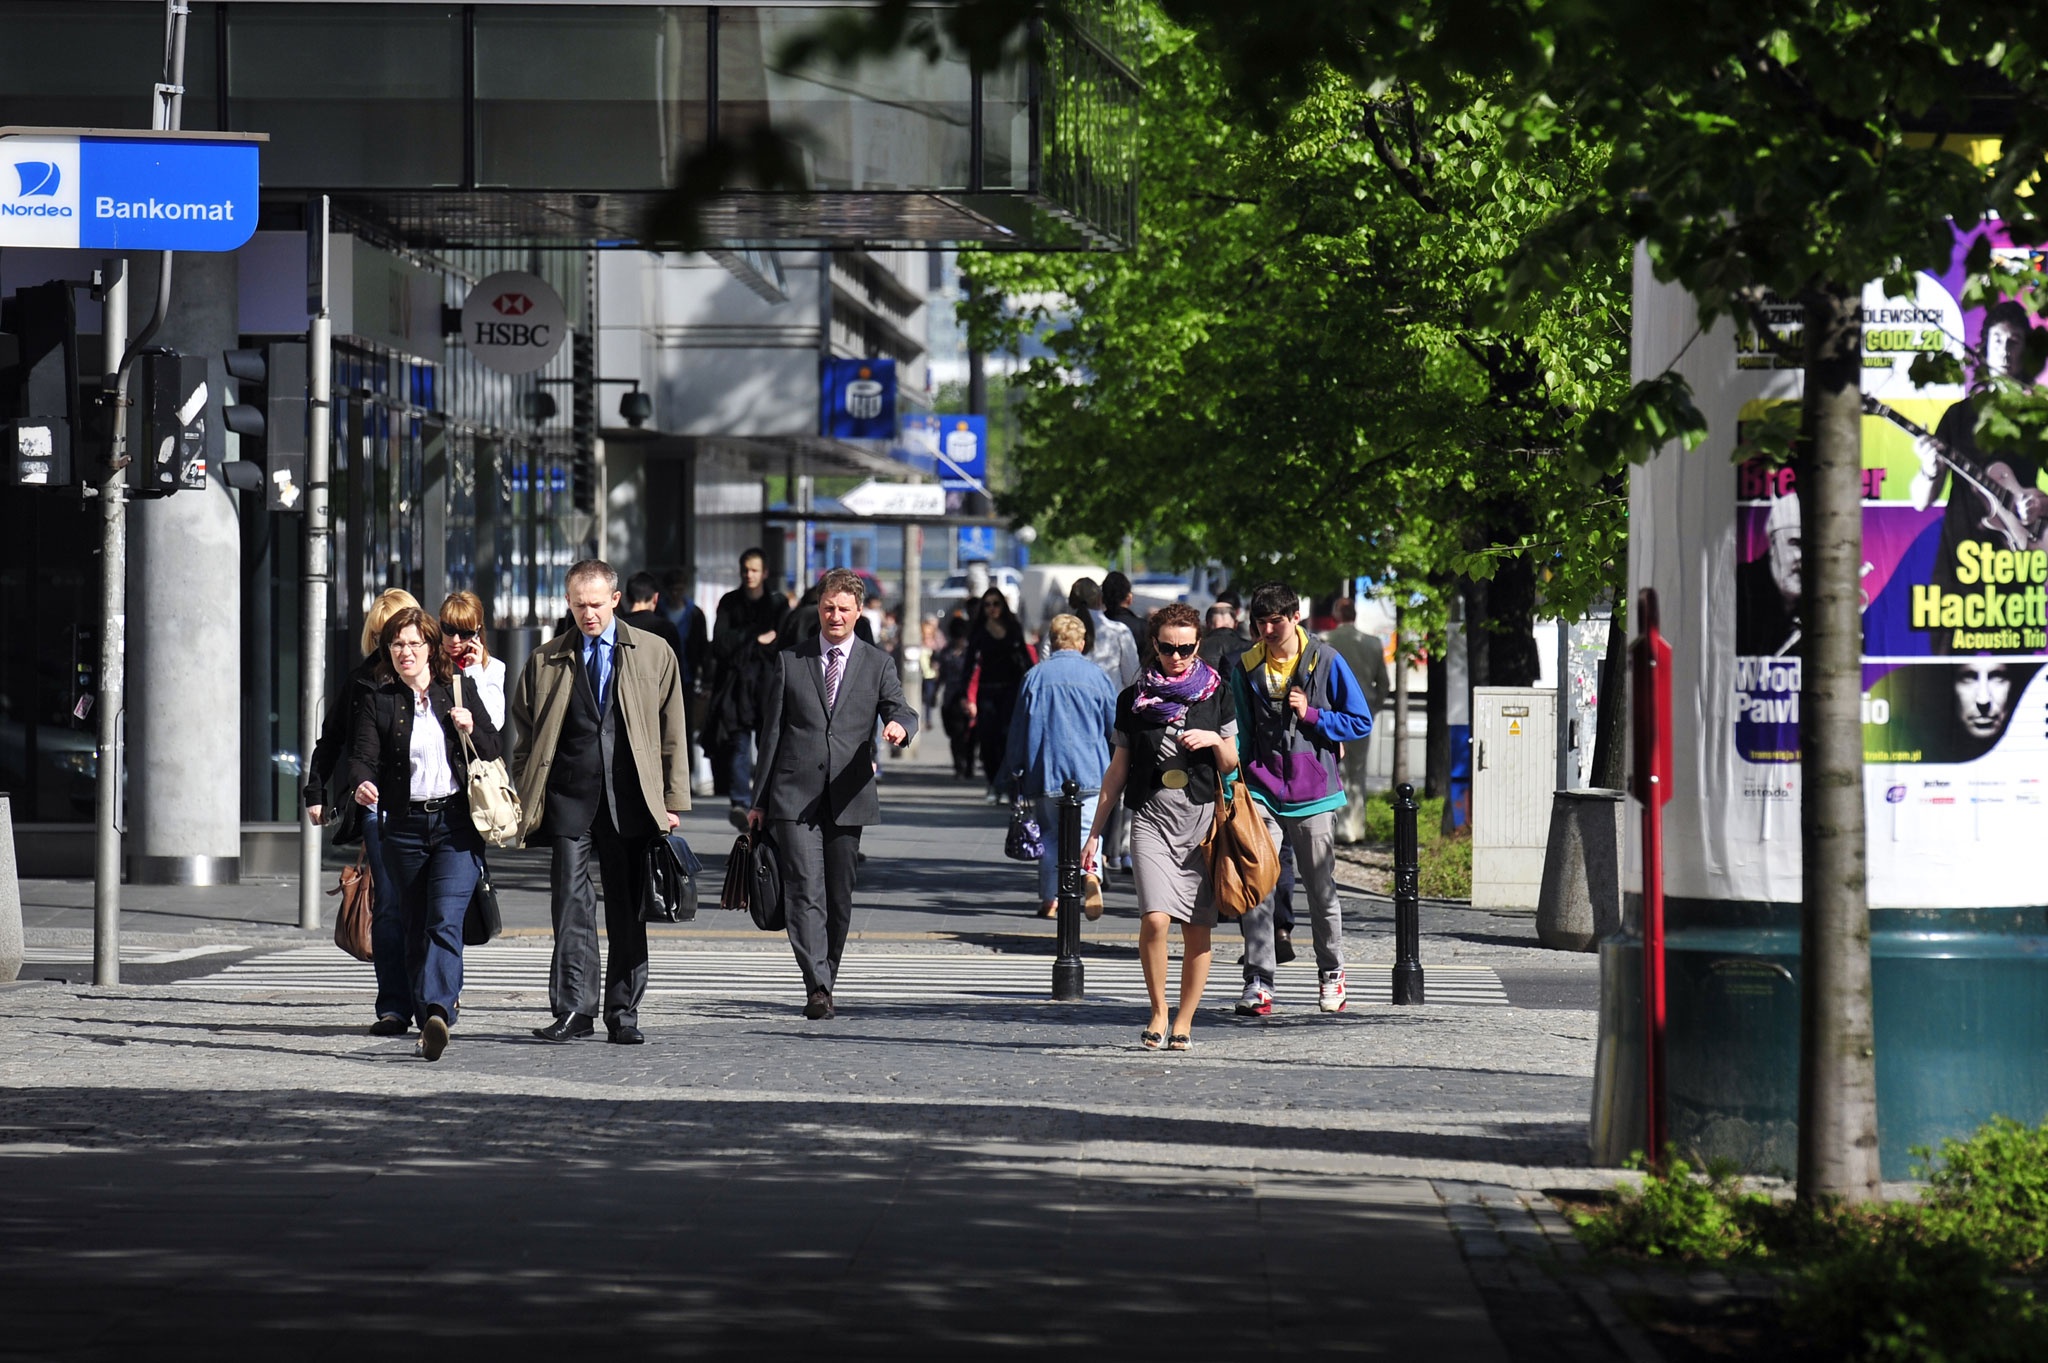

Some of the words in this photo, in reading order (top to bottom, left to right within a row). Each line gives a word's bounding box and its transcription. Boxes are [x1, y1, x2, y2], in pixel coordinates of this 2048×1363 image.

[1, 203, 73, 217] Nordea
[95, 196, 235, 221] Bankomat
[474, 321, 550, 347] HSBC
[1956, 539, 2047, 585] Steve
[1912, 584, 2047, 629] Hackett
[1952, 628, 2020, 649] Acoustic
[2022, 627, 2047, 649] Trio
[1736, 656, 1801, 692] Włod
[1735, 692, 1800, 723] Pawl
